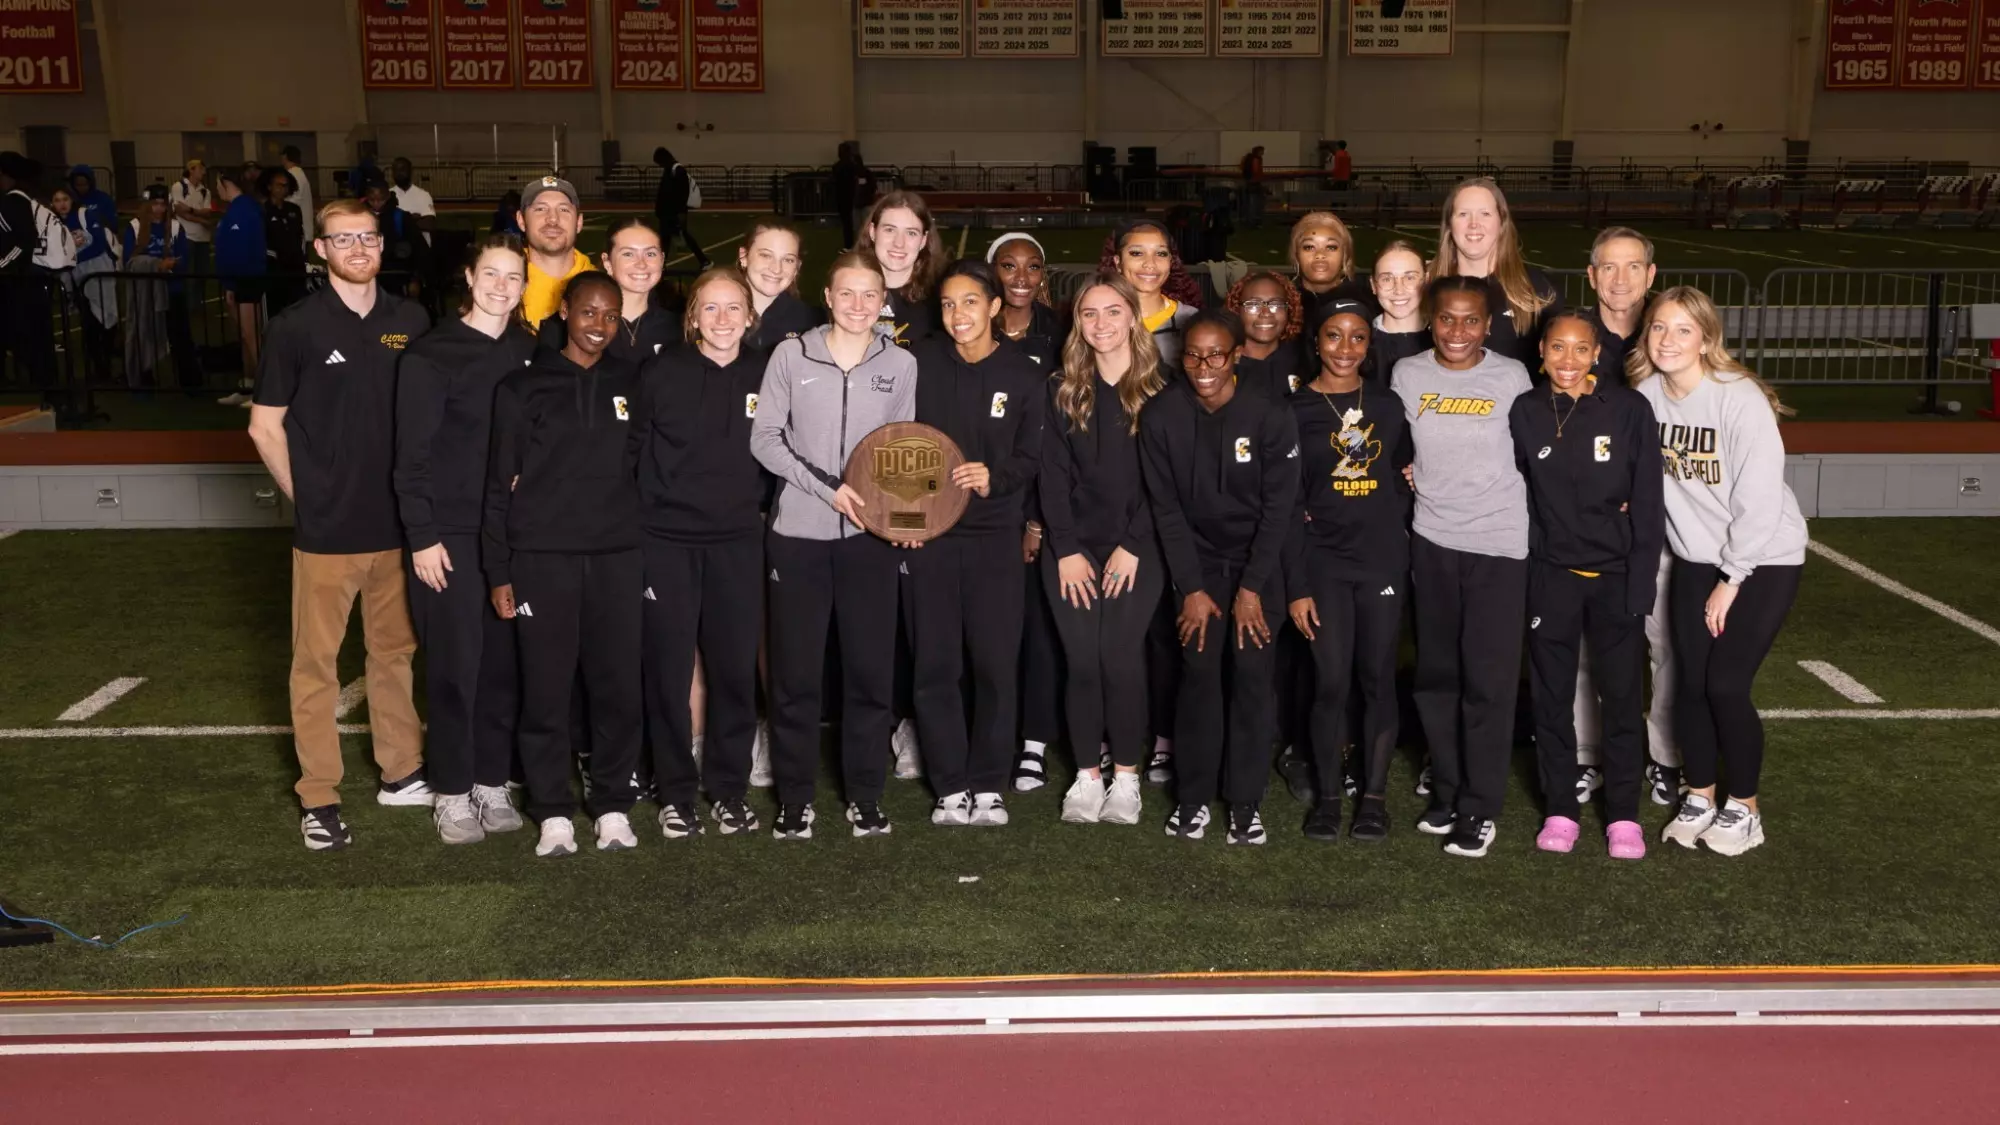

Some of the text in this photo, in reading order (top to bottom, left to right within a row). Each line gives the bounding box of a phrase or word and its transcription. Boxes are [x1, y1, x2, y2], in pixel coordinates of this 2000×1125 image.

[0, 0, 71, 11] AMPIONS
[367, 16, 428, 26] Fourth Place
[445, 16, 507, 26] Fourth Place
[524, 16, 585, 26] Fourth Place
[624, 12, 671, 20] NATIONAL
[696, 16, 756, 26] THIRD PLACE
[1003, 12, 1023, 20] 2012
[1028, 12, 1048, 20] 2013
[1053, 12, 1072, 20] 2014
[1272, 12, 1291, 20] 2014
[1834, 14, 1893, 25] Fourth Place
[620, 20, 676, 30] RUNNER-UP
[1908, 17, 1967, 28] Fourth Place
[1987, 18, 2000, 27] Thi
[2, 25, 55, 39] Football
[978, 27, 998, 35] 2015
[1028, 27, 1048, 35] 2021
[1052, 27, 1072, 35] 2022
[1108, 26, 1204, 34] 2017 2018 2019 2020
[1222, 26, 1316, 34] 2017 2018 2021 2022
[1355, 25, 1448, 33] 1982 1983 1984 1985
[1852, 32, 1872, 40] Men's
[1912, 33, 1961, 41] Men's Outdoor
[368, 42, 429, 52] Track & Field
[447, 43, 507, 52] Track & Field
[526, 42, 586, 52] Track & Field
[619, 42, 678, 52] Track & Field
[915, 41, 934, 49] 1997
[938, 41, 960, 49] 2000
[979, 41, 1049, 49] 2023 2024 2025
[1108, 40, 1203, 48] 2022 2023 2024 2025
[1222, 40, 1292, 48] 2023 2024 2025
[1354, 39, 1399, 47] 2021 2023
[1832, 42, 1891, 53] Cross Country
[697, 44, 758, 53] Track & Field
[1907, 44, 1965, 53] Track & Field
[0, 56, 70, 85] 2011
[371, 59, 428, 81] 2016
[450, 60, 505, 81] 2017
[528, 60, 583, 80] 2017
[621, 60, 678, 81] 2024
[700, 62, 756, 82] 2025
[1833, 60, 1887, 80] 1965
[1908, 60, 1961, 80] 1989
[1981, 60, 2000, 81] 19
[380, 333, 408, 344] CLOUD
[871, 375, 896, 385] Cloud
[871, 383, 893, 393] Track
[1416, 393, 1496, 420] T-BIRDS
[1333, 480, 1378, 491] CLOUD
